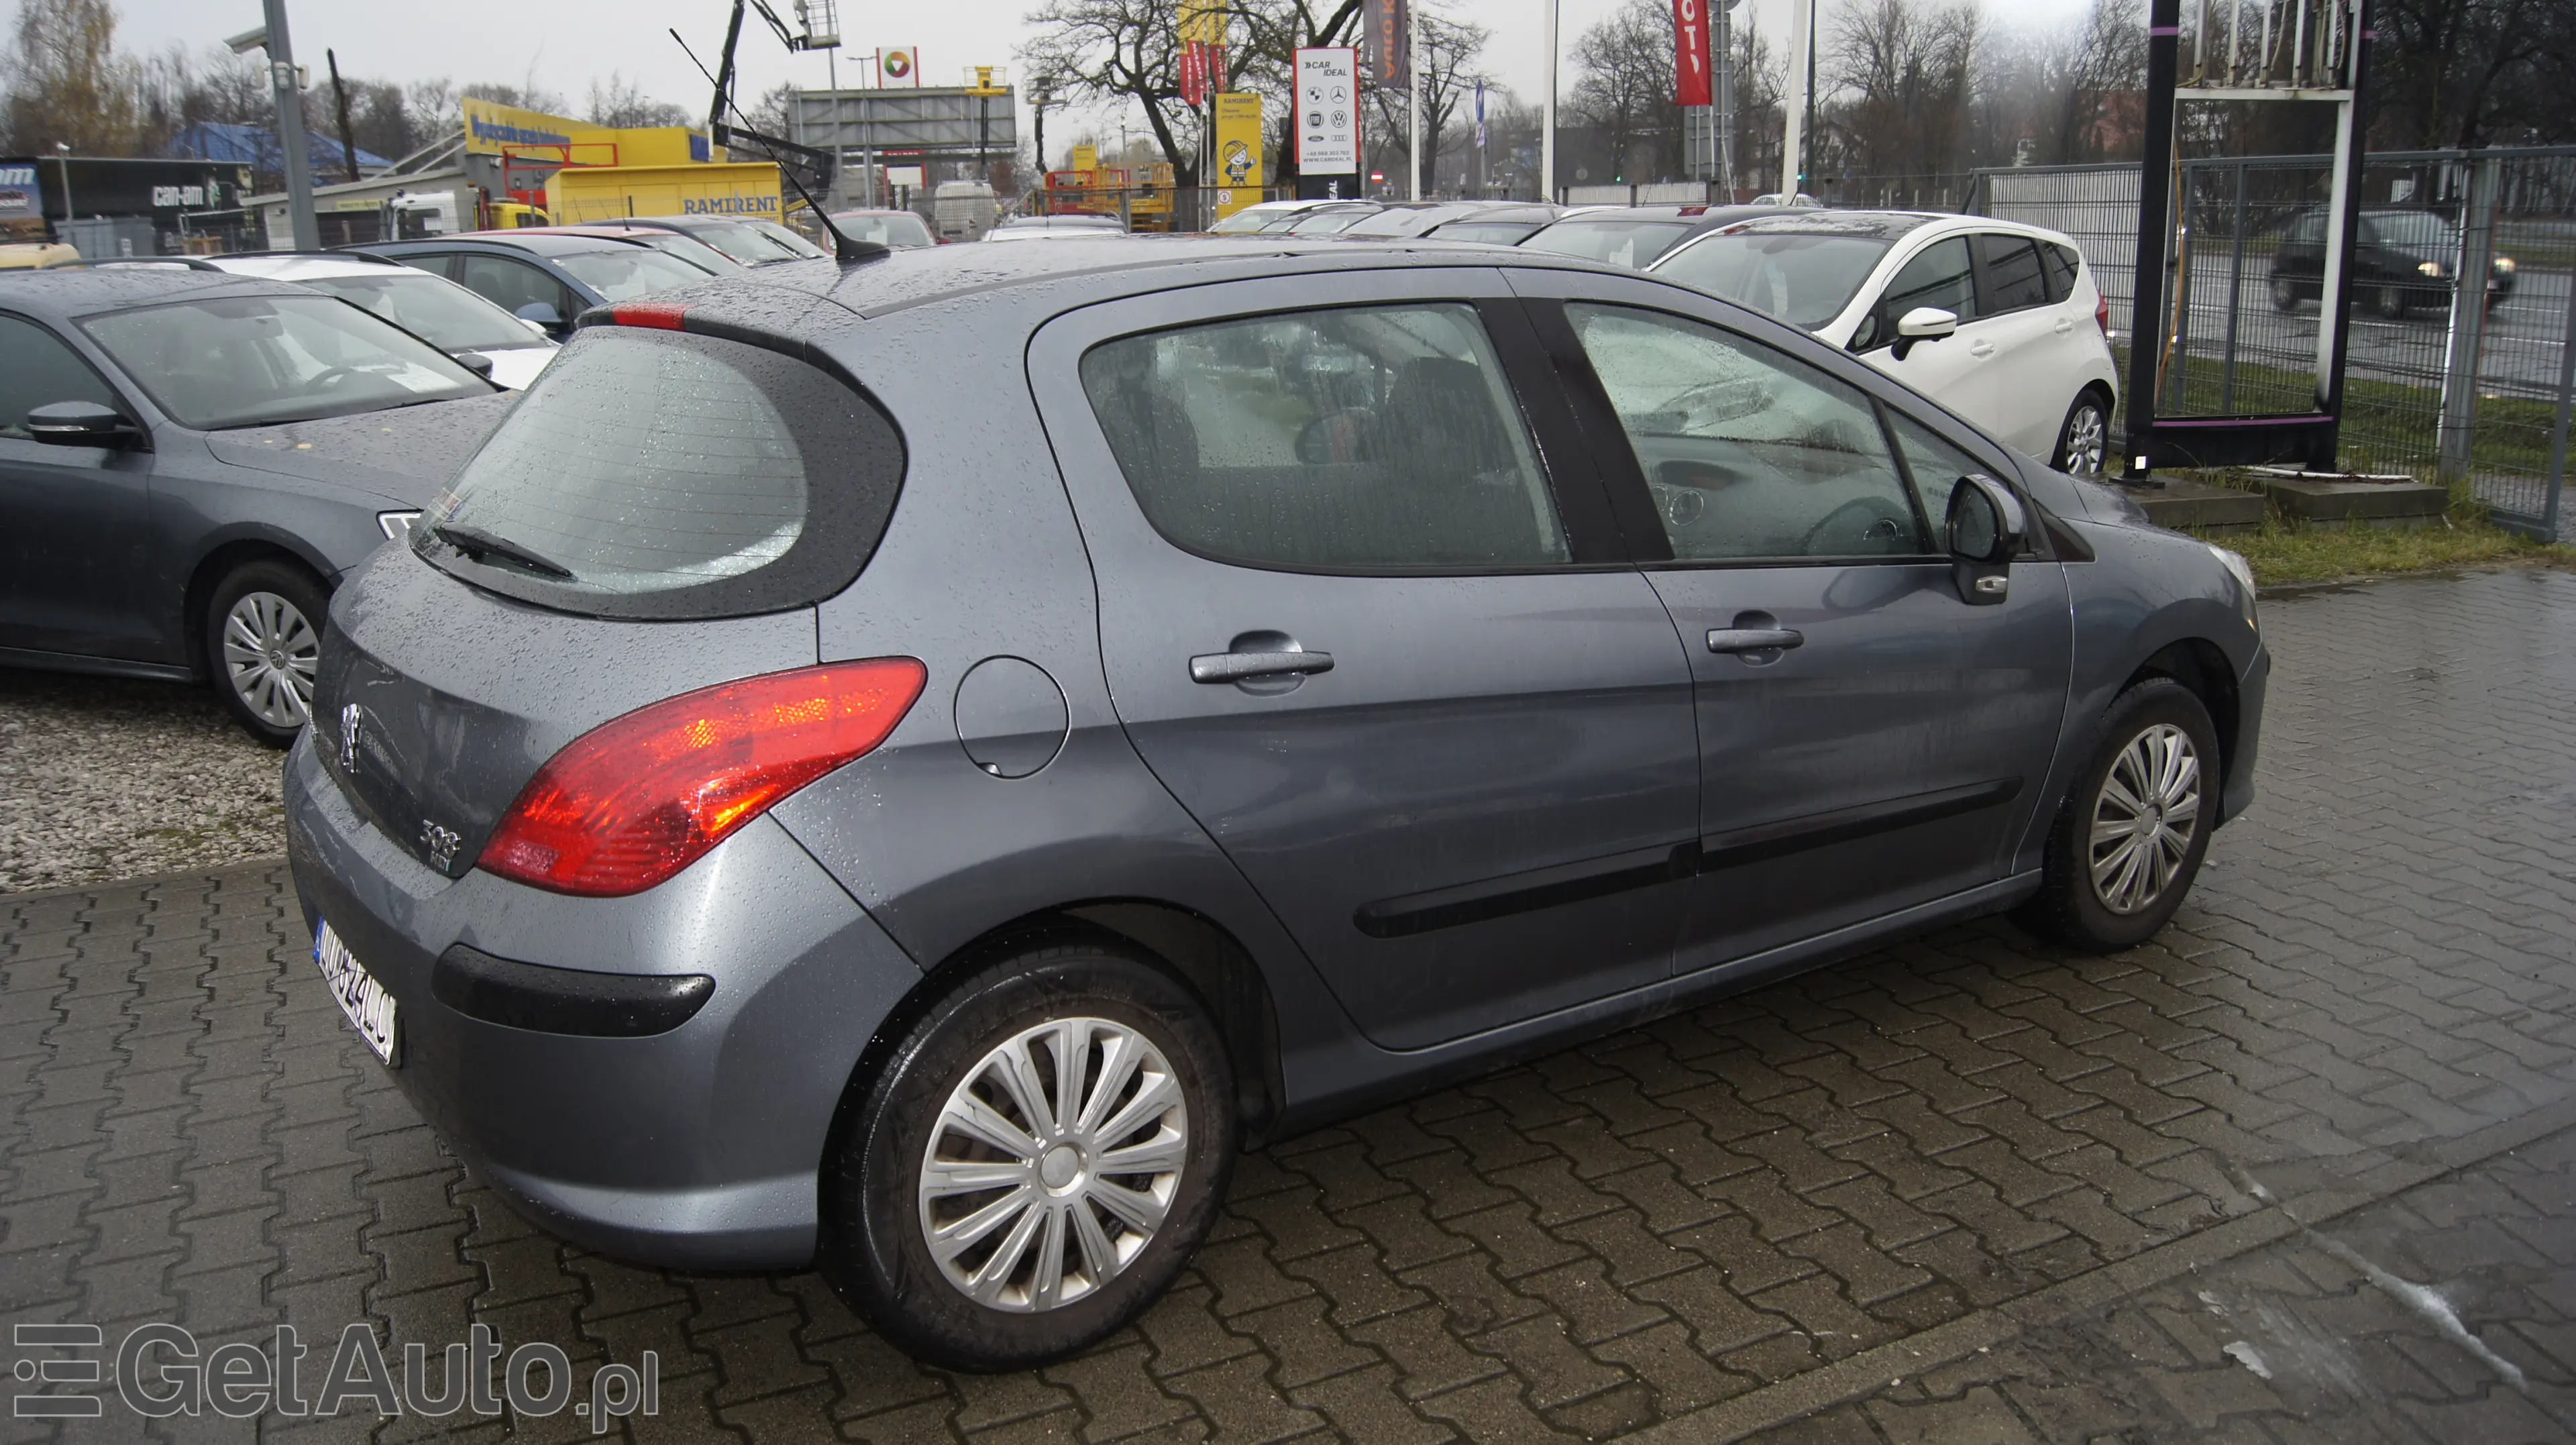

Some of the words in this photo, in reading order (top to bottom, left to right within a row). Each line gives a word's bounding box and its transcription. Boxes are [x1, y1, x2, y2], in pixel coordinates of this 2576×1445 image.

[1323, 68, 1347, 76] IDEAL
[152, 185, 204, 207] can-am
[1329, 179, 1338, 199] EAL
[682, 196, 778, 215] RAMIRENT
[420, 819, 460, 858] 308
